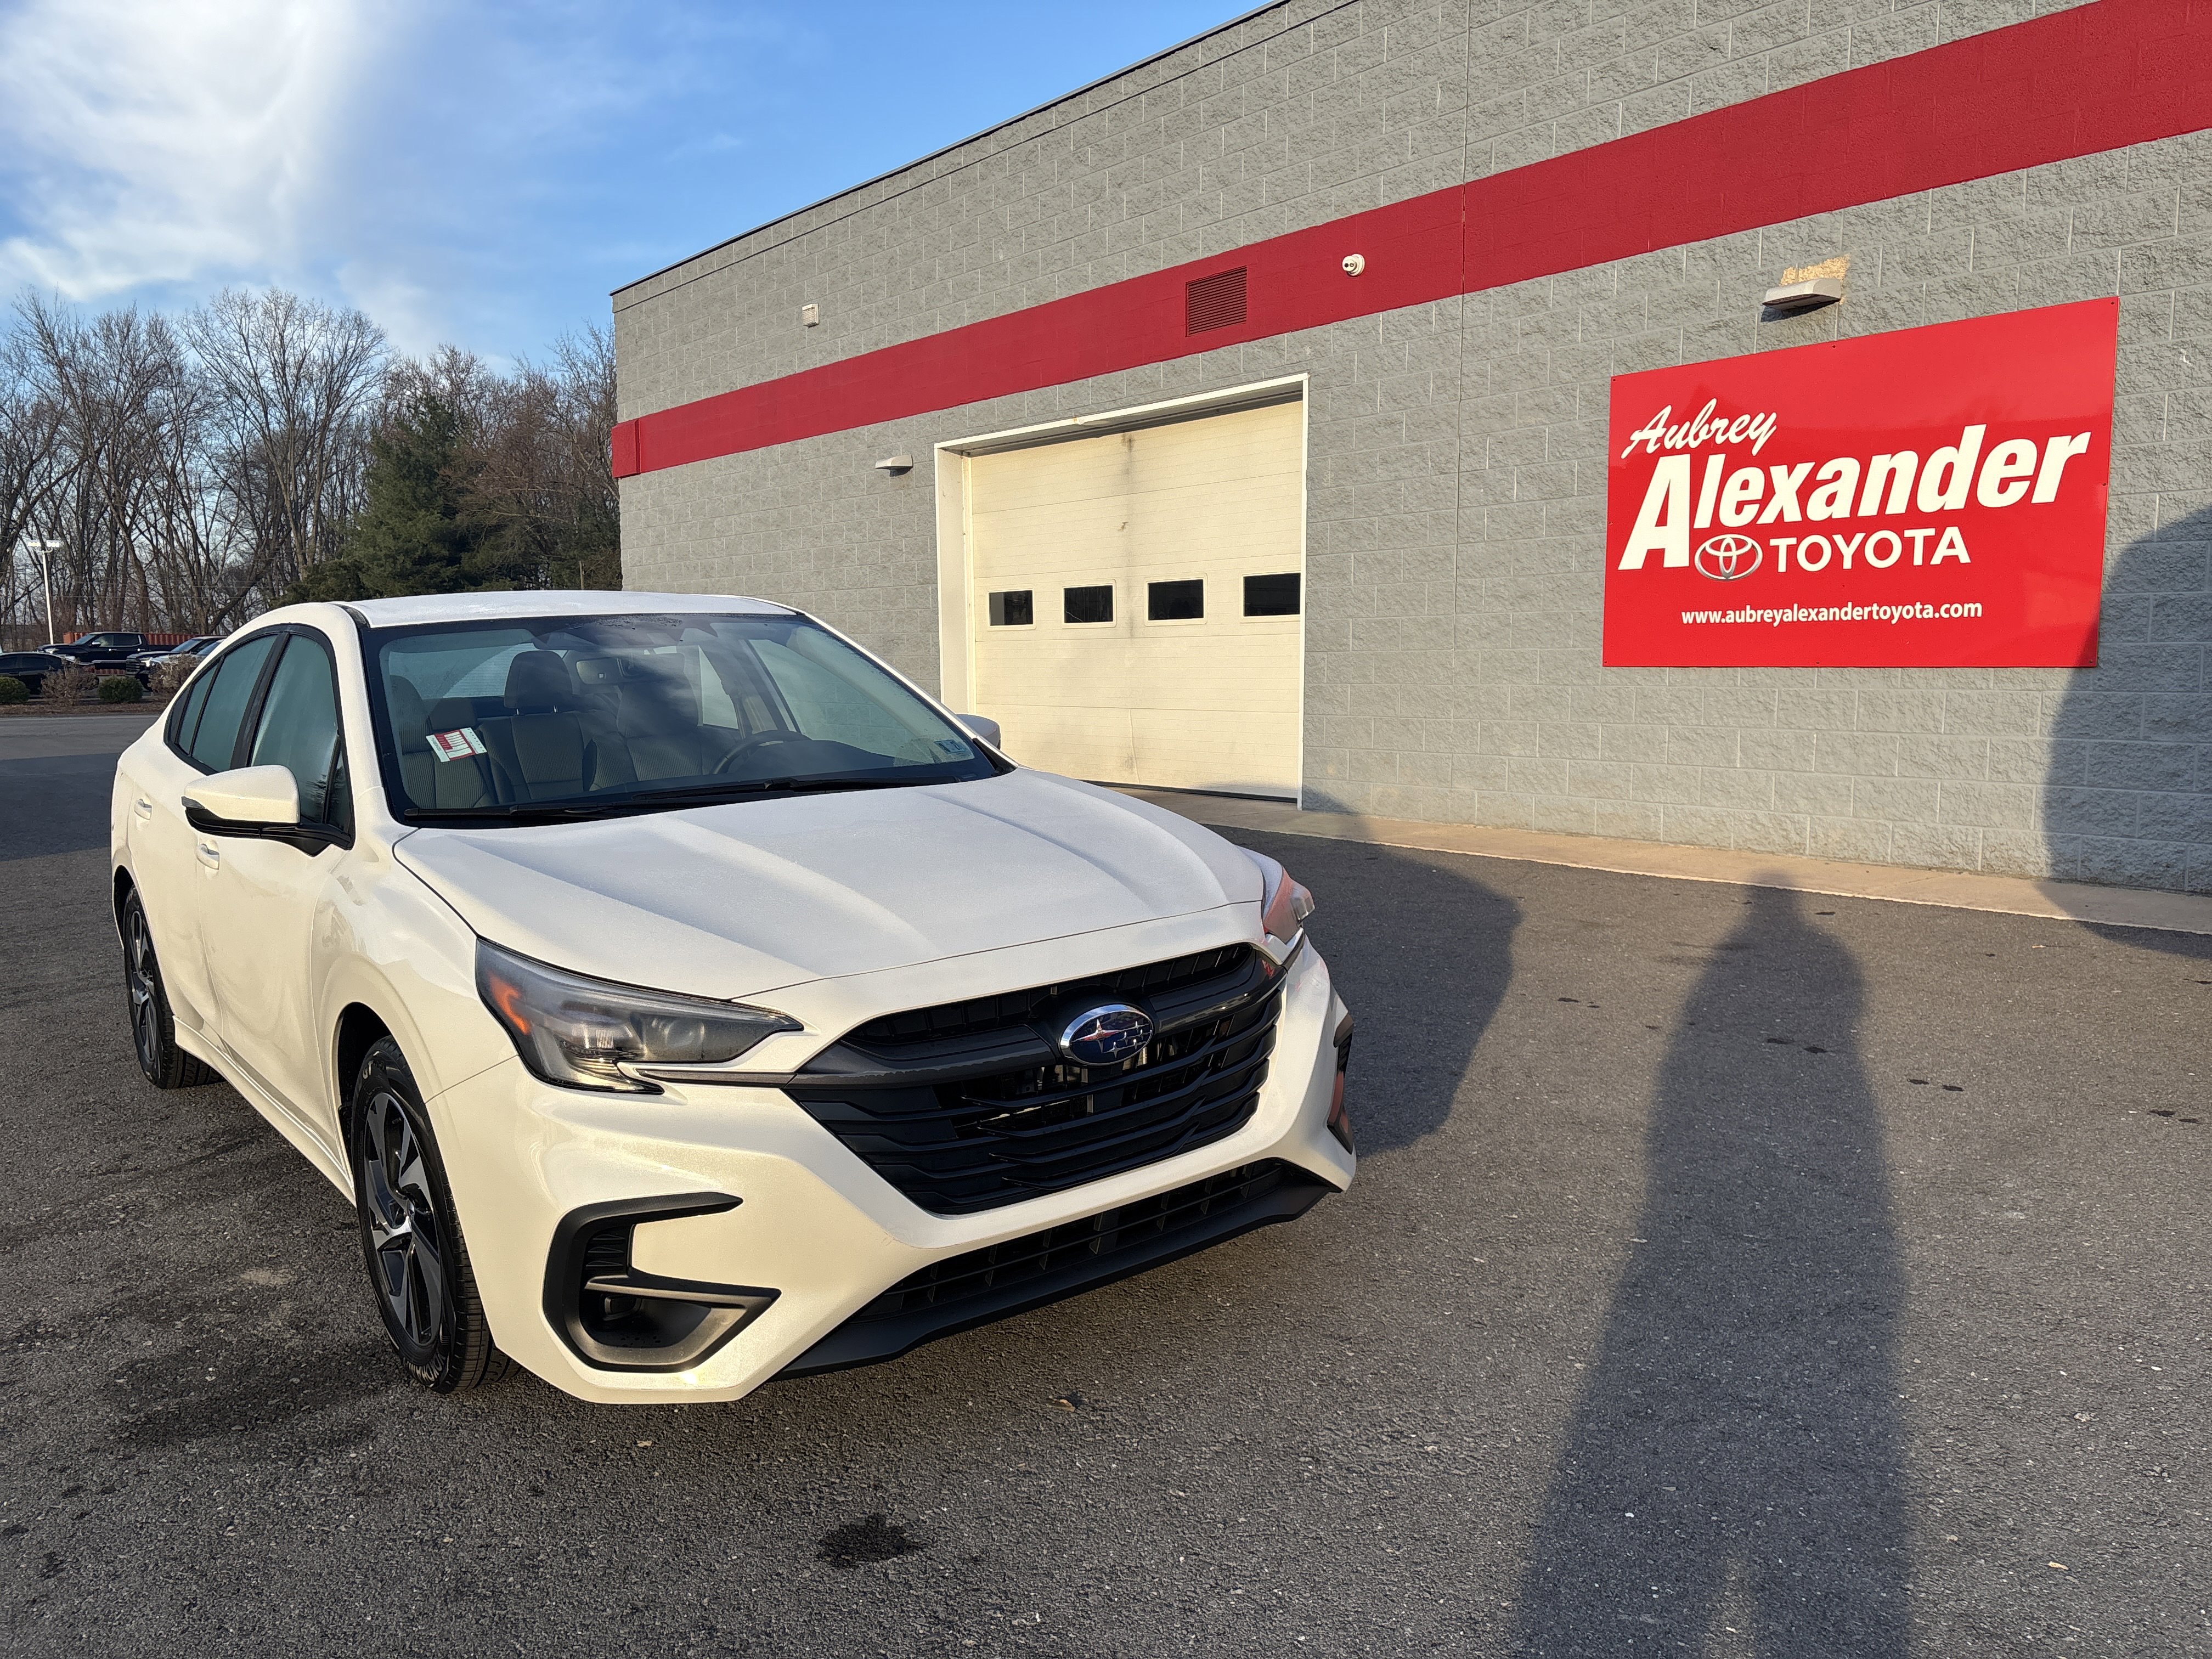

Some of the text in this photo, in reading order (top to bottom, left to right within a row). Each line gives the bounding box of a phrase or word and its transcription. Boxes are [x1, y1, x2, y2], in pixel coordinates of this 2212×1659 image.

[1621, 398, 1777, 458] Aubrey
[1617, 424, 2092, 571] Alexander
[1769, 526, 1971, 573] TOYOTA
[1681, 601, 1982, 627] www.aubreyalexandertoyota.com
